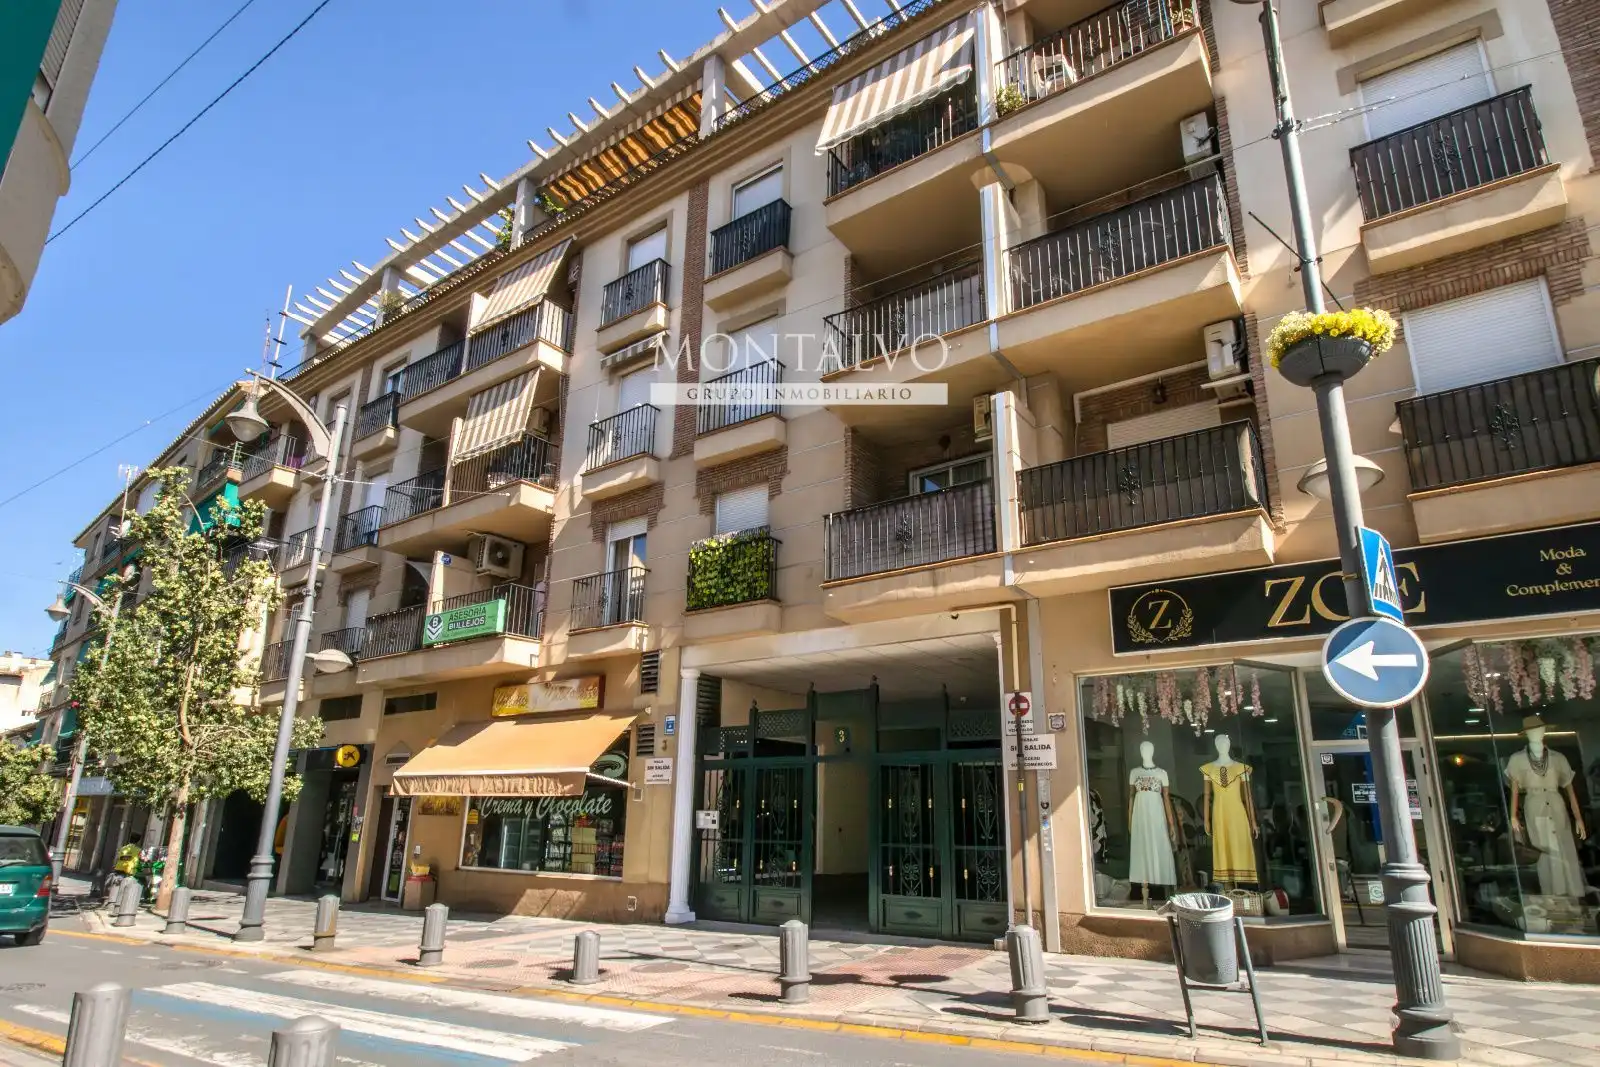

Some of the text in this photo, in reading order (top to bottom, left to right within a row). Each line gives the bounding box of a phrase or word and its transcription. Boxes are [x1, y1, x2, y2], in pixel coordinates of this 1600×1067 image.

[1539, 546, 1586, 562] Moda
[1556, 562, 1572, 576] &
[1147, 599, 1173, 630] Z
[838, 729, 845, 742] 3
[1024, 743, 1051, 751] SALIDA
[481, 795, 523, 818] Crema
[524, 800, 534, 824] y
